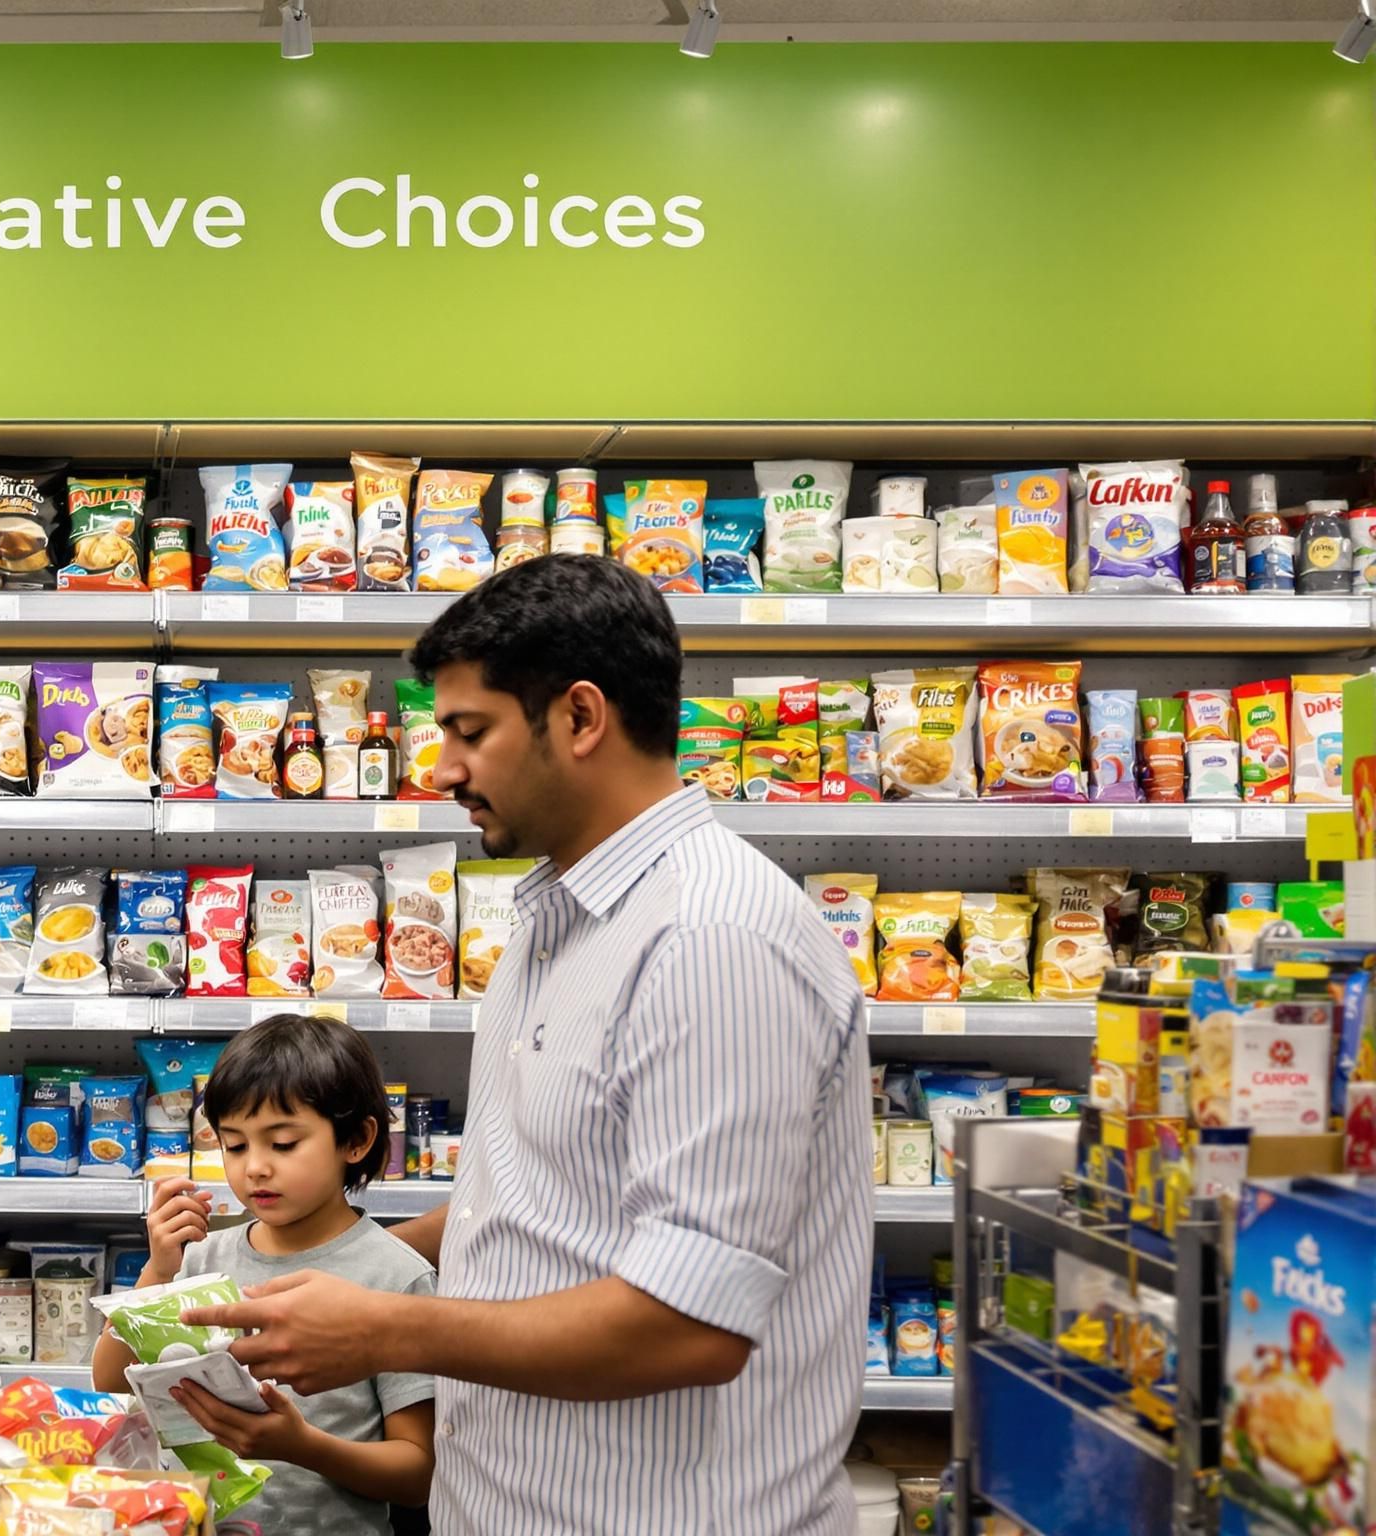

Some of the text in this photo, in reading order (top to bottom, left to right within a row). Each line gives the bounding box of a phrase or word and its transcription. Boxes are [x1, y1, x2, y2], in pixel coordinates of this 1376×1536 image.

[320, 173, 705, 249] Choices
[1088, 478, 1173, 507] Lafkin
[992, 681, 1074, 711] CRIKES
